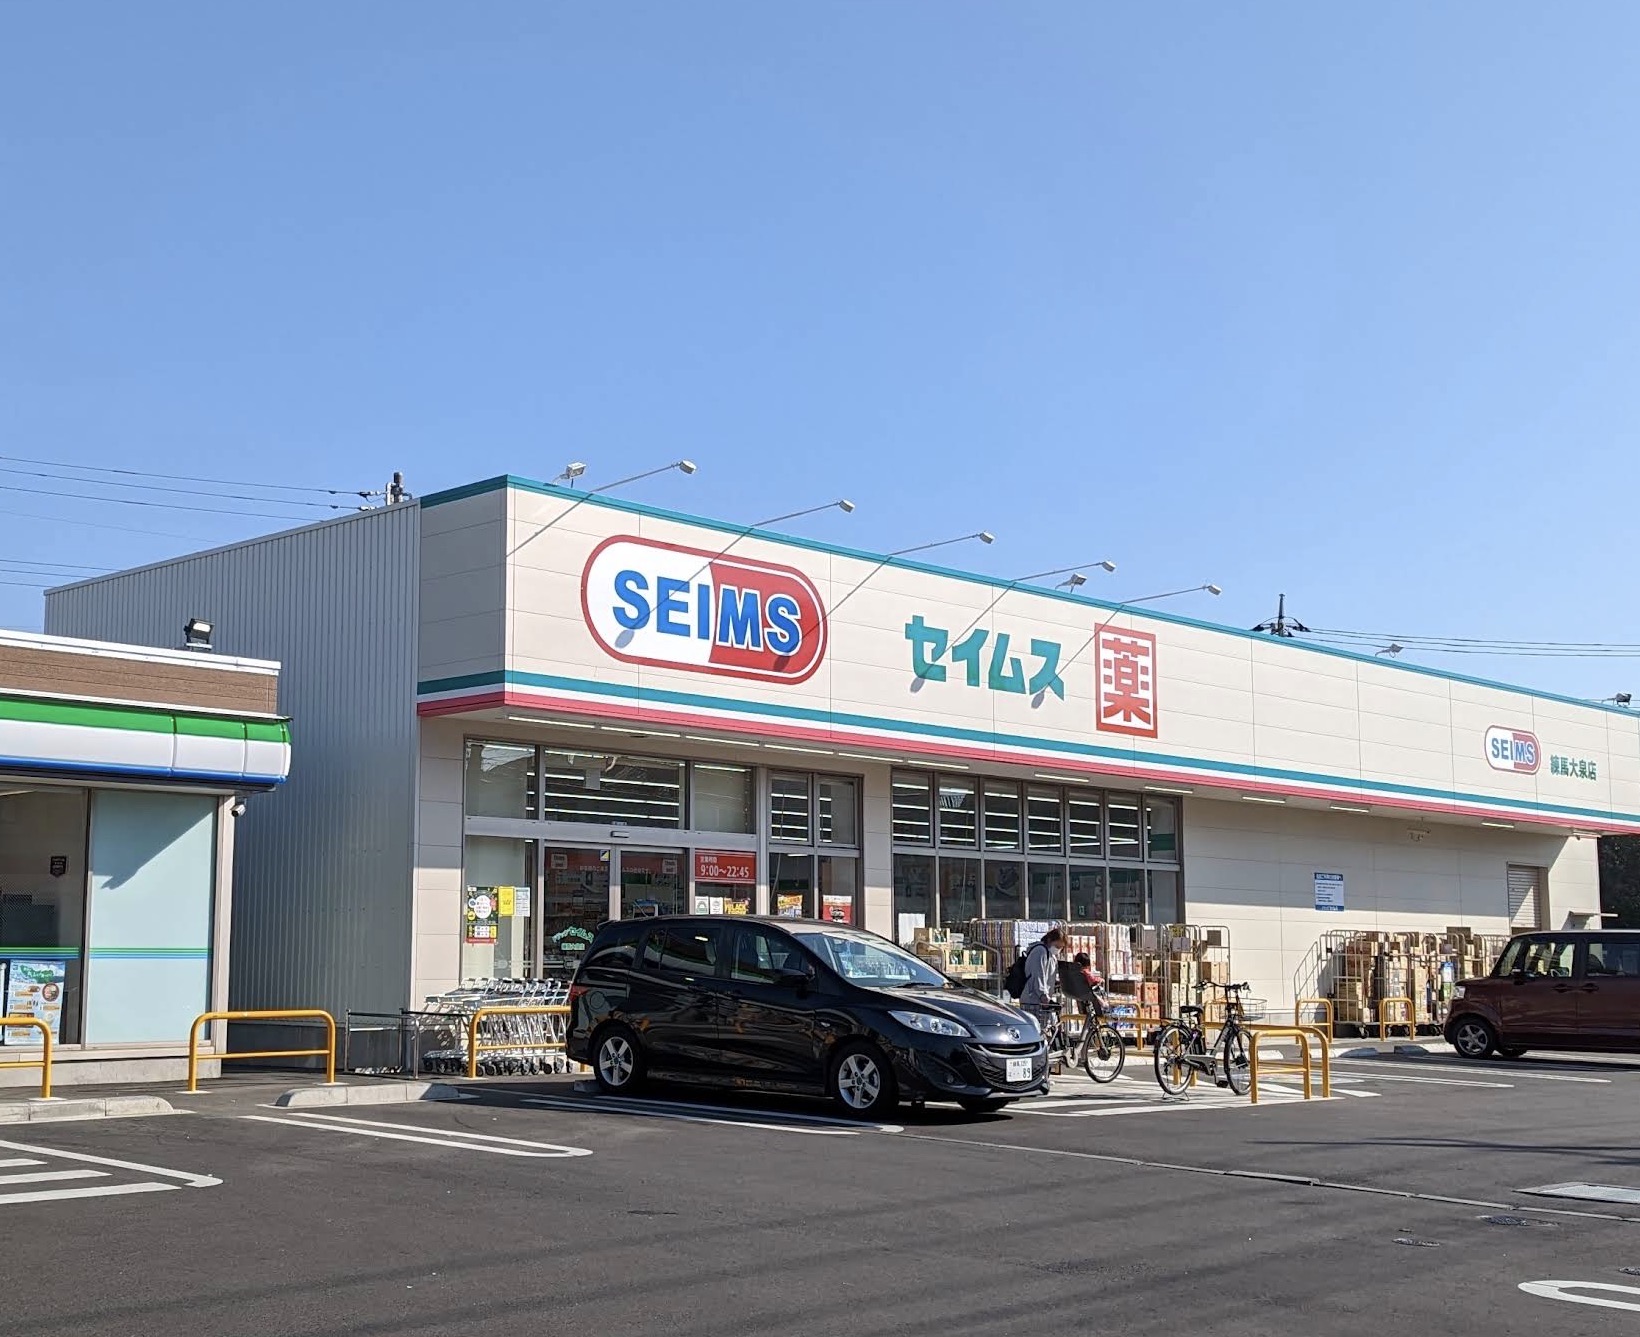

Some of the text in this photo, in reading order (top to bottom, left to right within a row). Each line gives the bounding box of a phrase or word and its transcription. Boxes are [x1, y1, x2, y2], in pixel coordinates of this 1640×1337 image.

[612, 569, 801, 655] SEIMS
[904, 614, 1065, 701] セイムス
[1101, 637, 1151, 725] 薬
[1491, 737, 1536, 765] SEIMS
[1550, 755, 1597, 781] 練馬大泉店
